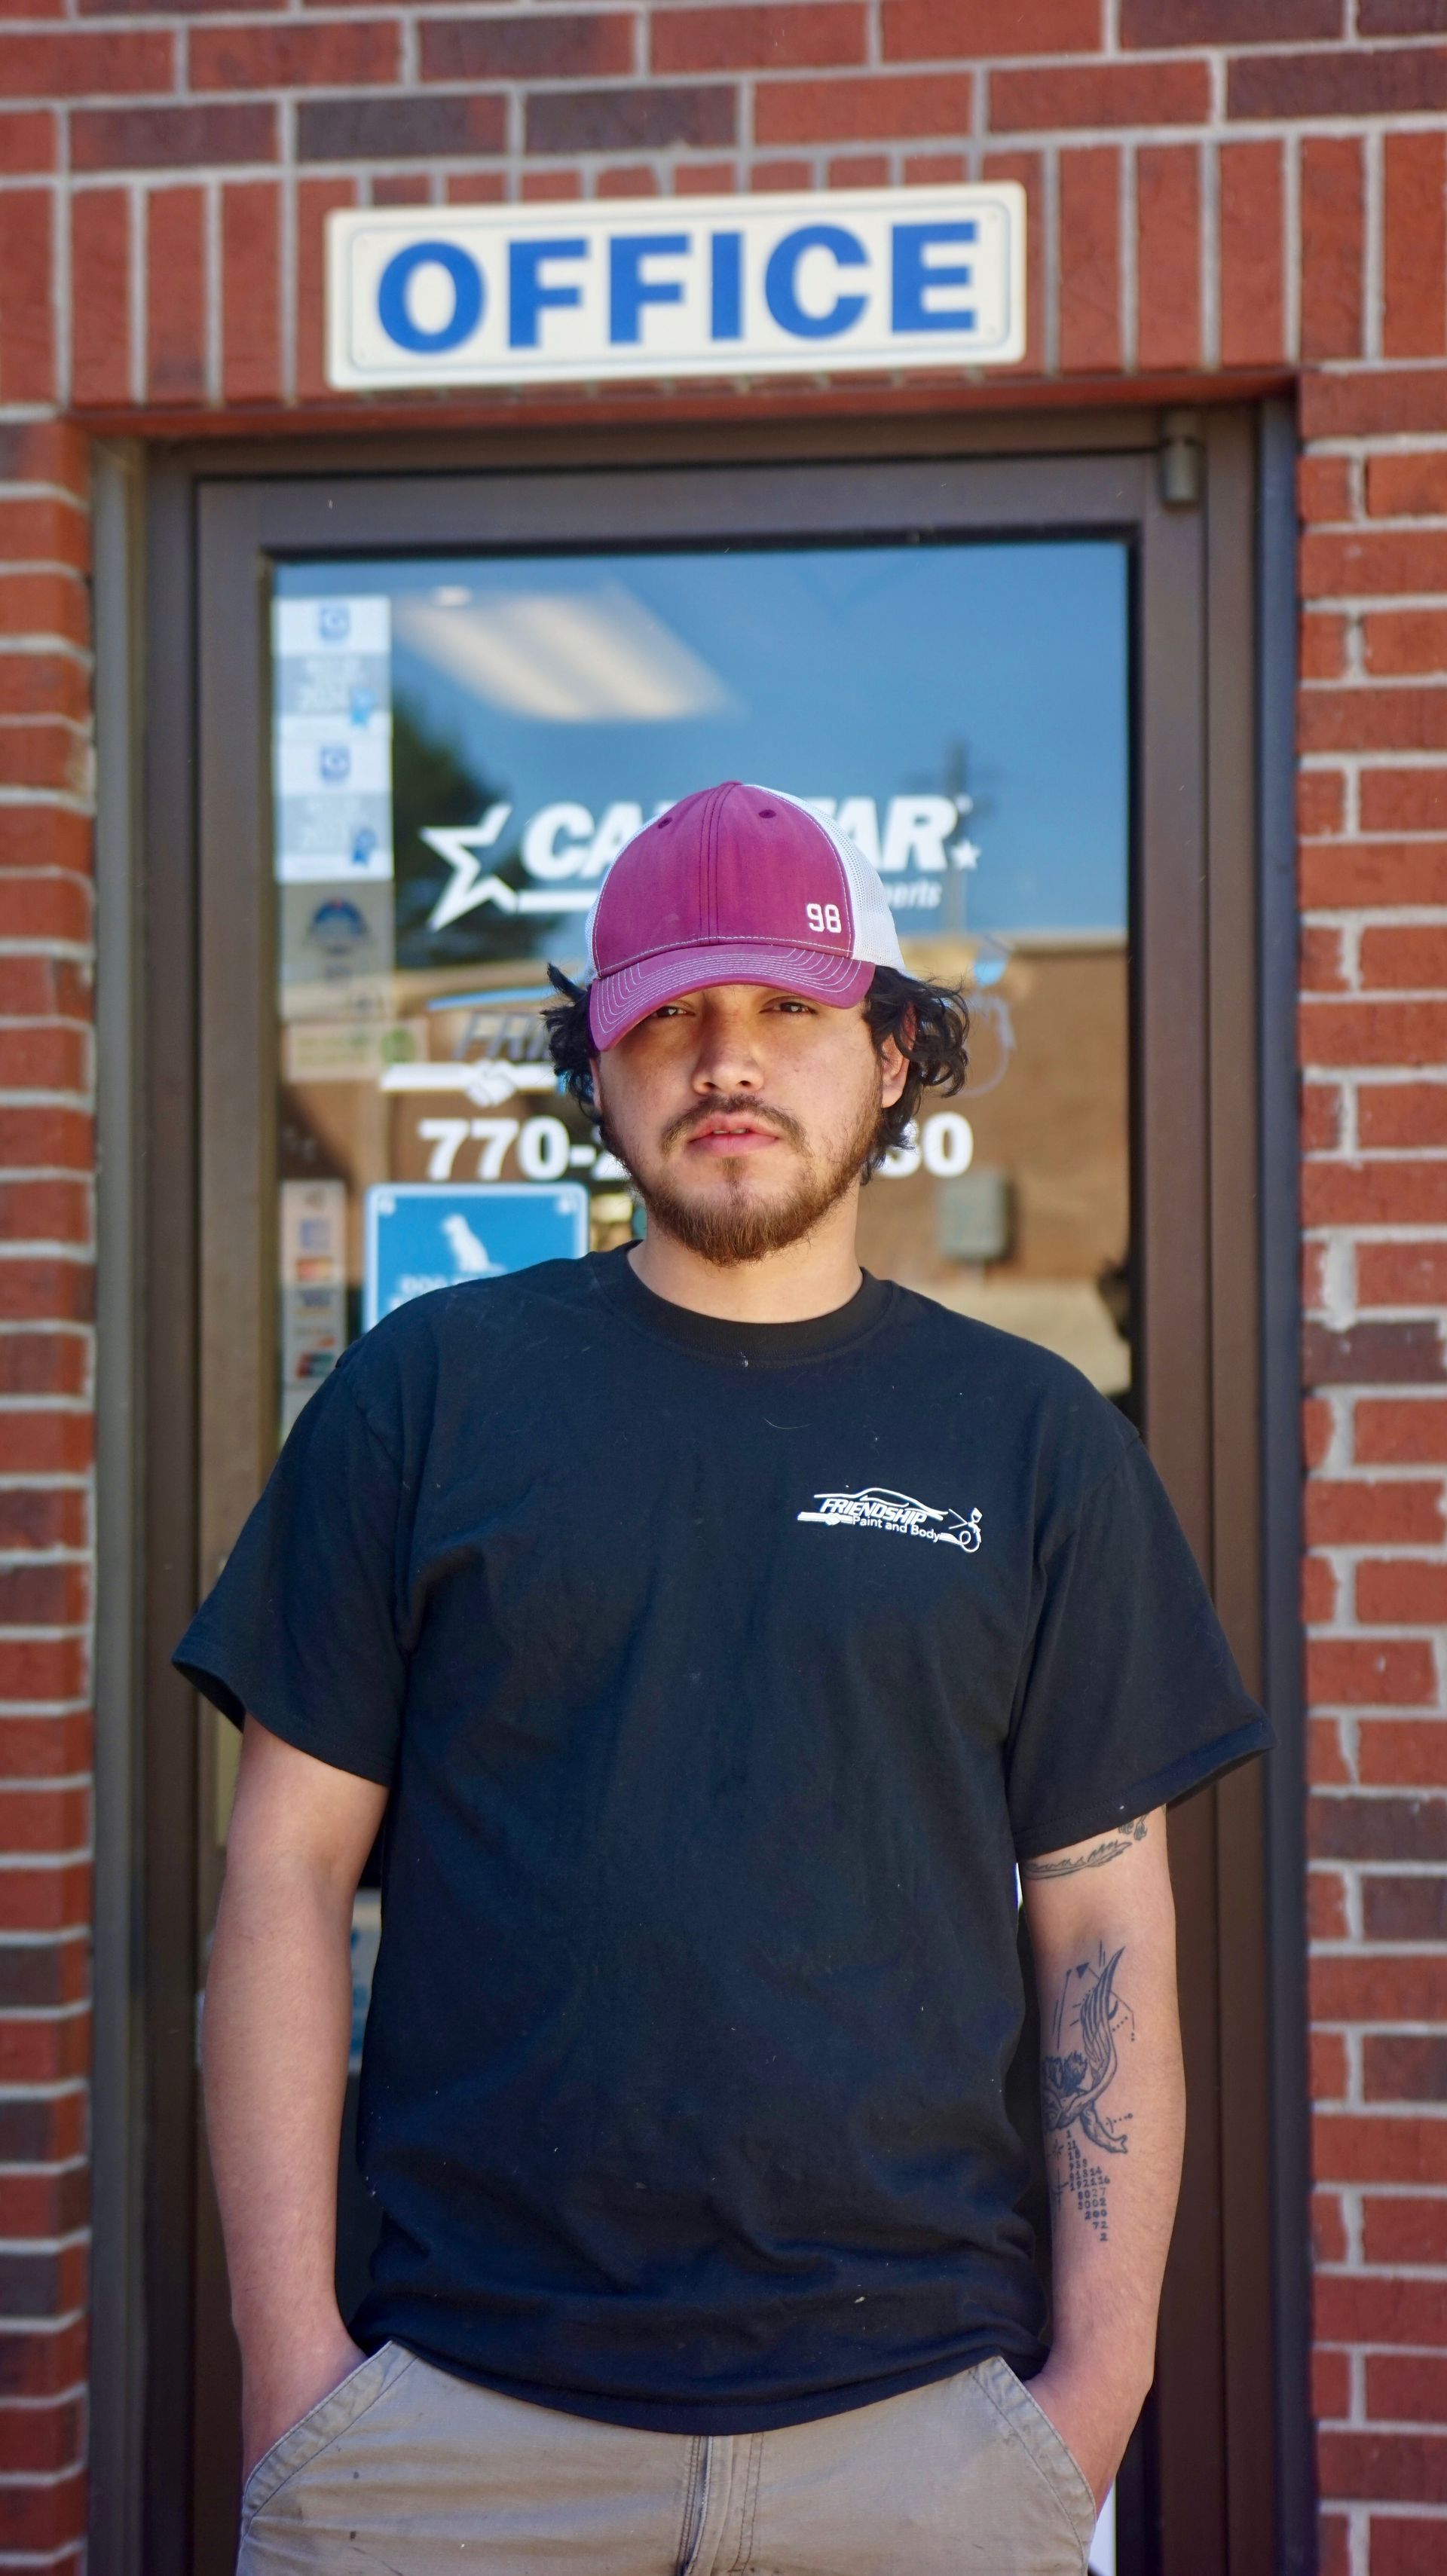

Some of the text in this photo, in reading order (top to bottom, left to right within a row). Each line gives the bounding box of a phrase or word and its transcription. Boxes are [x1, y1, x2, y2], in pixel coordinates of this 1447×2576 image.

[378, 221, 977, 356] OFFICE
[806, 903, 842, 933] 98
[820, 1498, 928, 1526] FRIENDSHIP
[852, 1515, 941, 1543] Paint and Body
